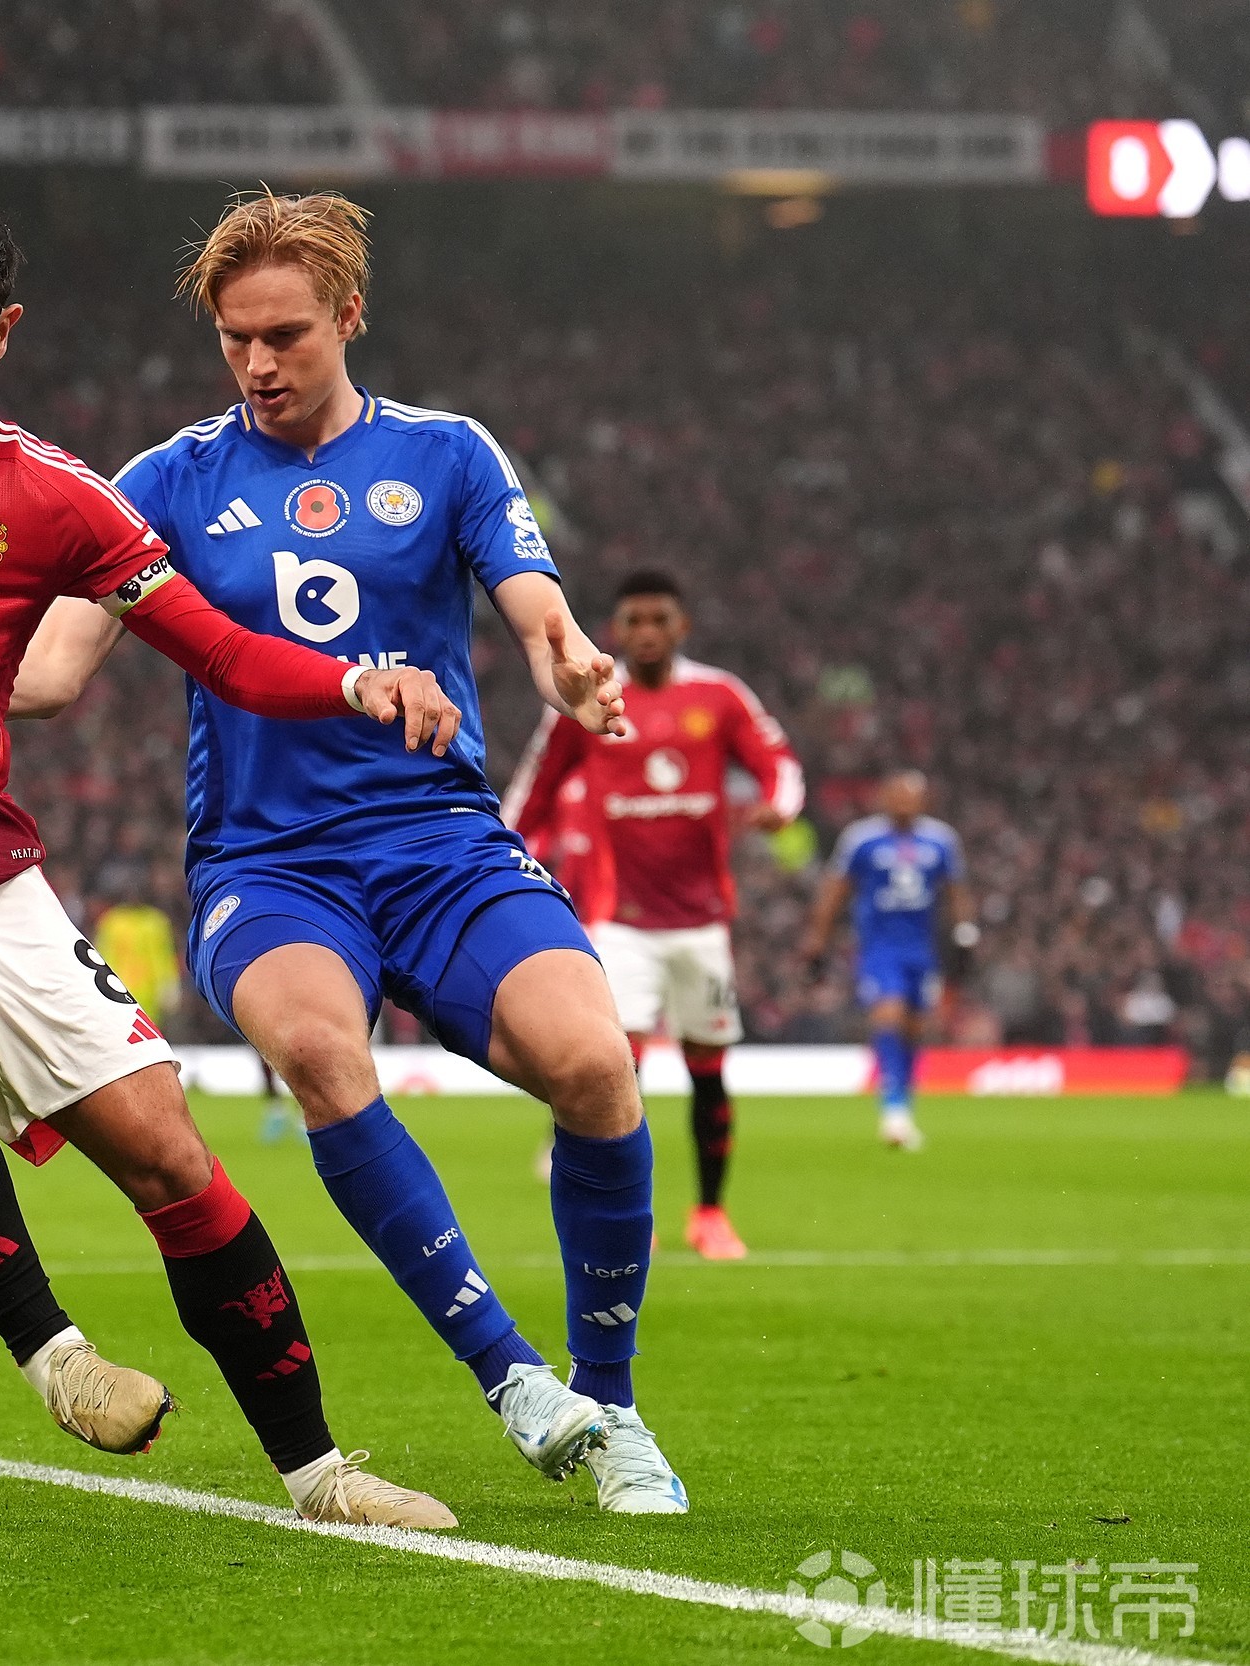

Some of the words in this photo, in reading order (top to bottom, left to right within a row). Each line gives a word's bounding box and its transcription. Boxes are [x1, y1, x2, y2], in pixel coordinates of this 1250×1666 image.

[299, 479, 321, 488] UNITED
[405, 490, 416, 502] CITY
[404, 504, 416, 518] CLUB
[74, 939, 138, 1004] 8
[422, 1227, 459, 1258] LCFC
[583, 1262, 639, 1279] LCFC
